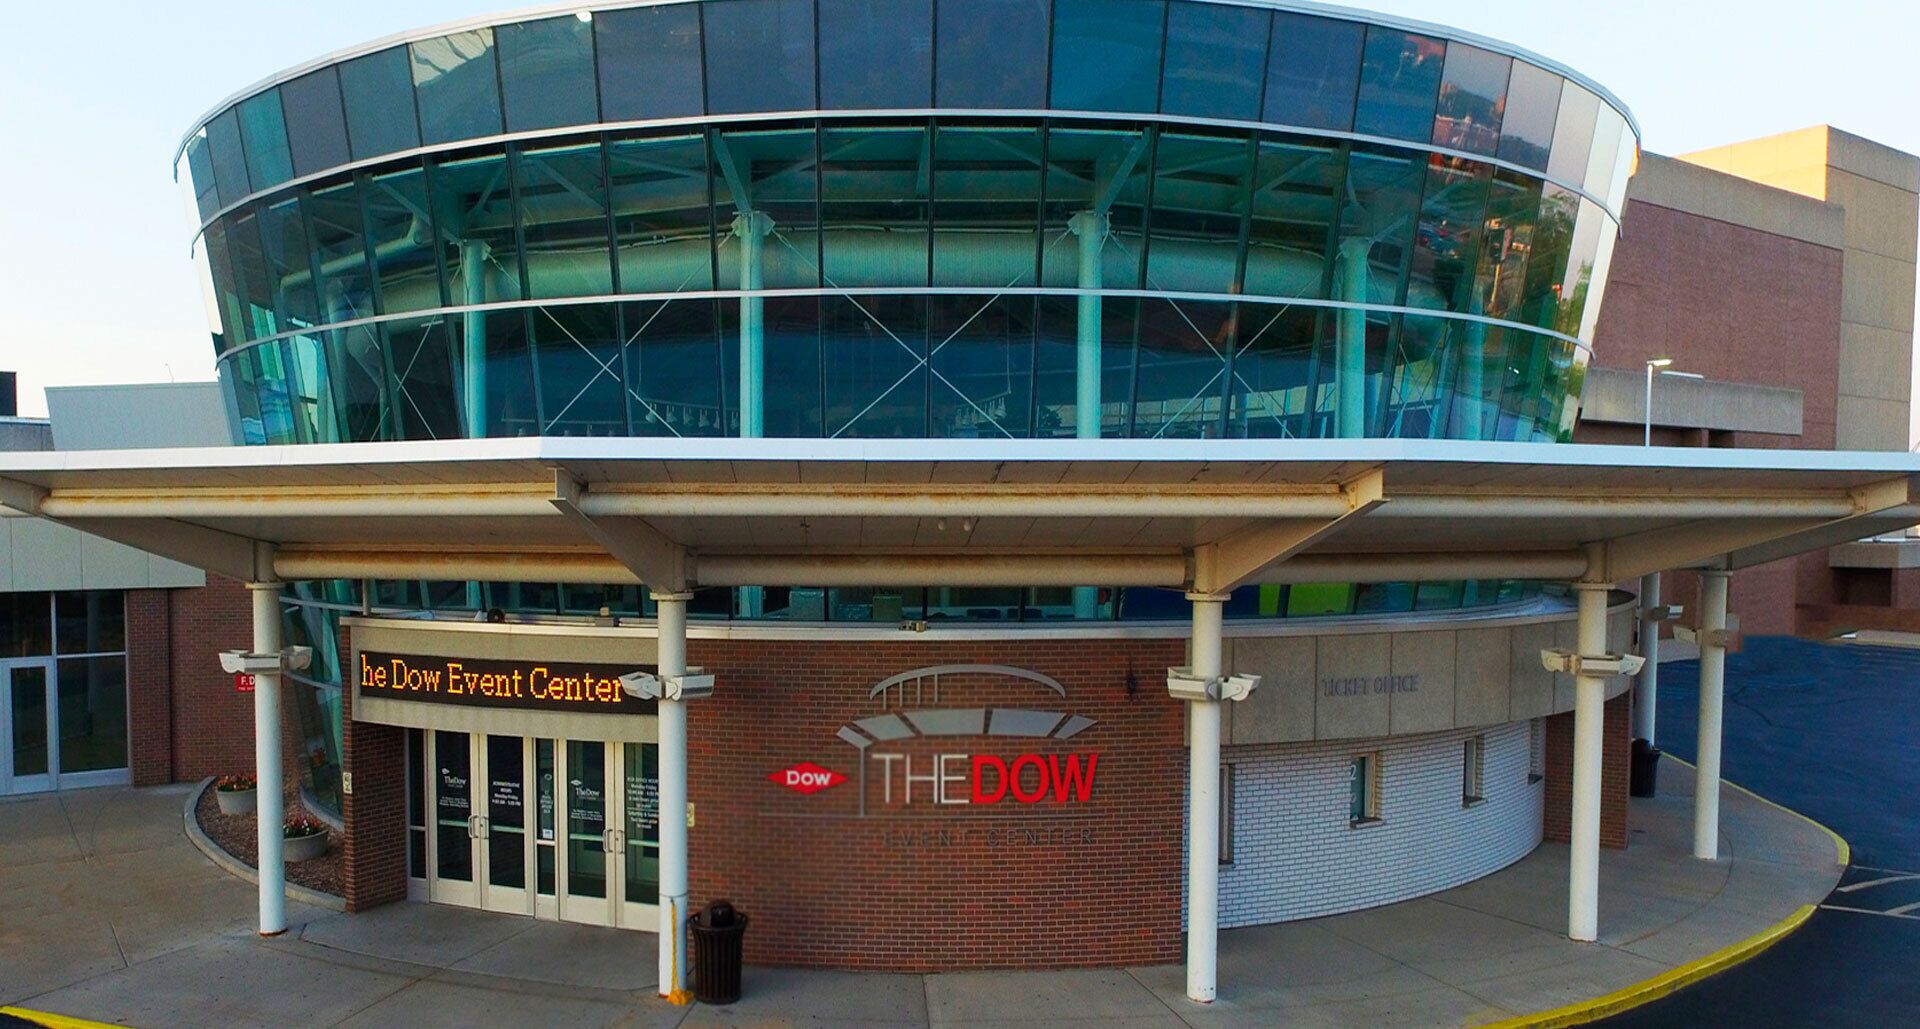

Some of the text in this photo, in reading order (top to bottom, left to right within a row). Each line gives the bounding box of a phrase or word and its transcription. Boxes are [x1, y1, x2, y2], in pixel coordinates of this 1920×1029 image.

[361, 654, 622, 703] he Dow Event Center
[1322, 674, 1419, 697] TICKET OFFICE
[785, 769, 832, 787] Dow
[986, 828, 1096, 847] CENTER
